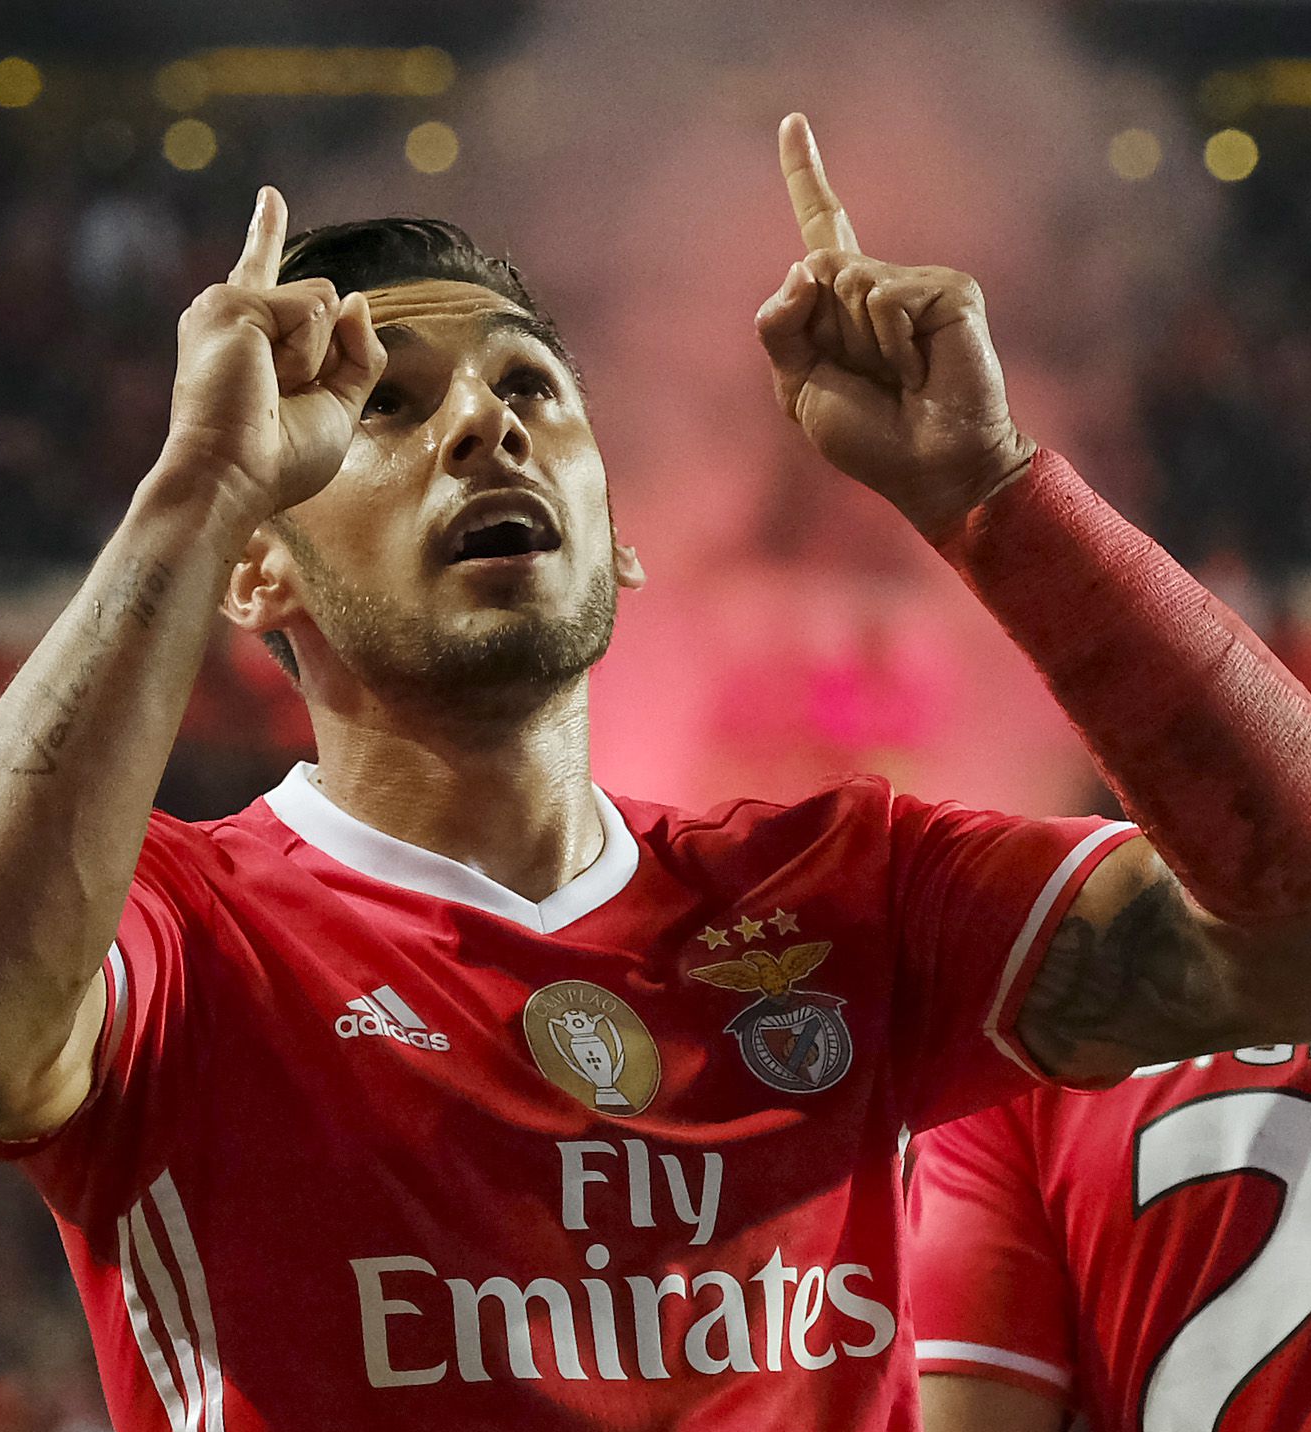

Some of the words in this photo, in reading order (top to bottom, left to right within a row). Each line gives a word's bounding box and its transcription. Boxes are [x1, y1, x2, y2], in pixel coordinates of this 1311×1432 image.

[334, 1012, 451, 1052] adidas
[555, 1138, 724, 1245] Fly
[348, 1243, 896, 1389] Emirates
